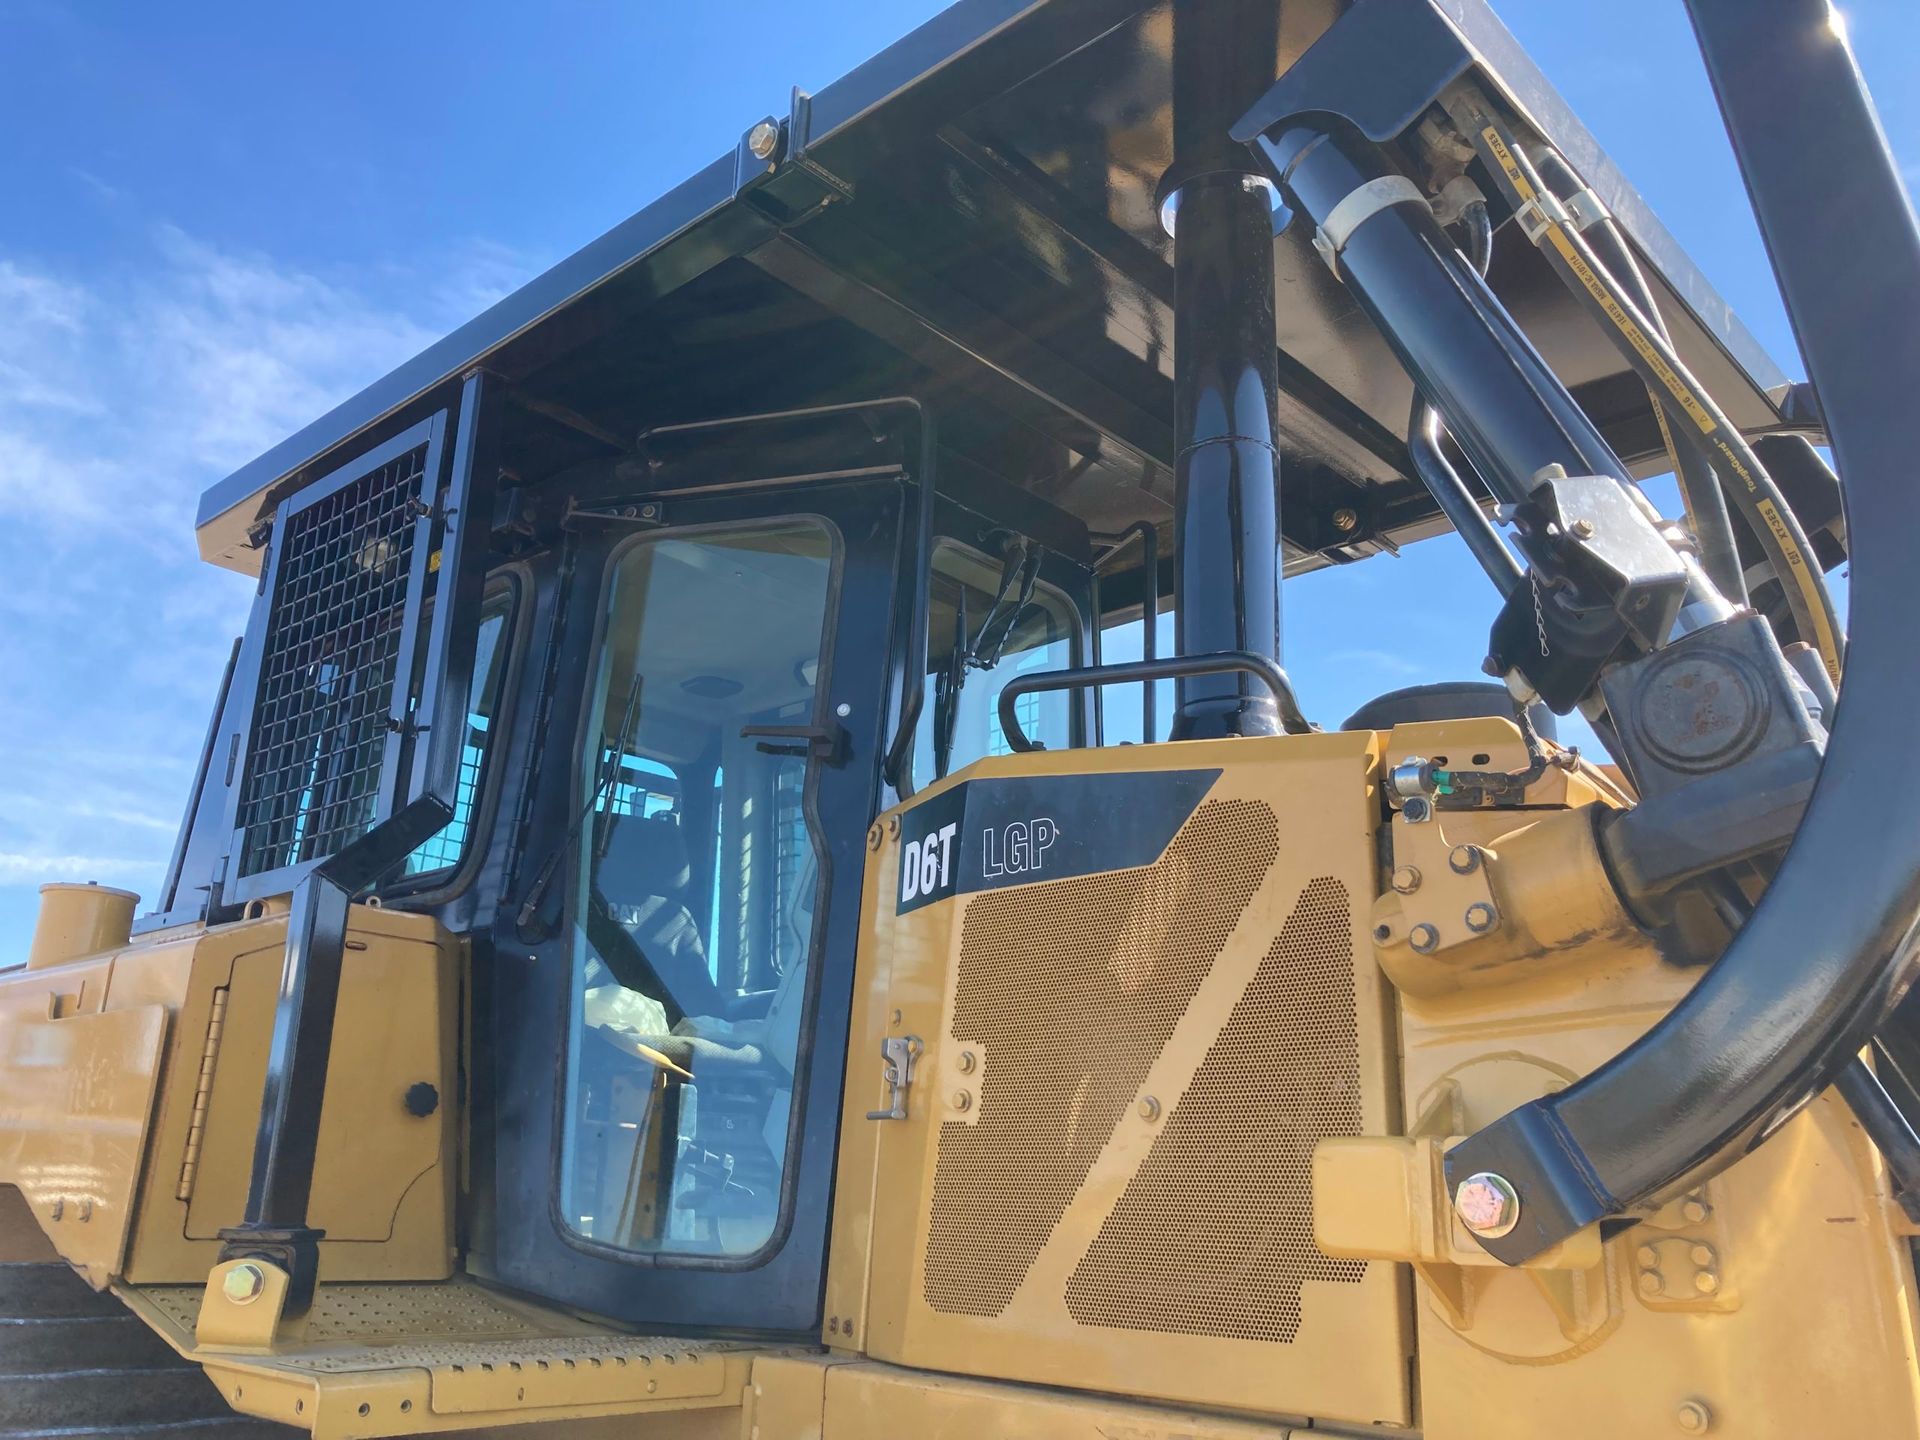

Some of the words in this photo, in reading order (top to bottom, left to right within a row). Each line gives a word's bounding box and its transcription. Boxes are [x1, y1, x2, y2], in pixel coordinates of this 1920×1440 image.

[1765, 508, 1789, 541] XT-3ES
[902, 822, 957, 903] D6T
[983, 818, 1056, 878] LGP
[608, 902, 640, 924] CAT
